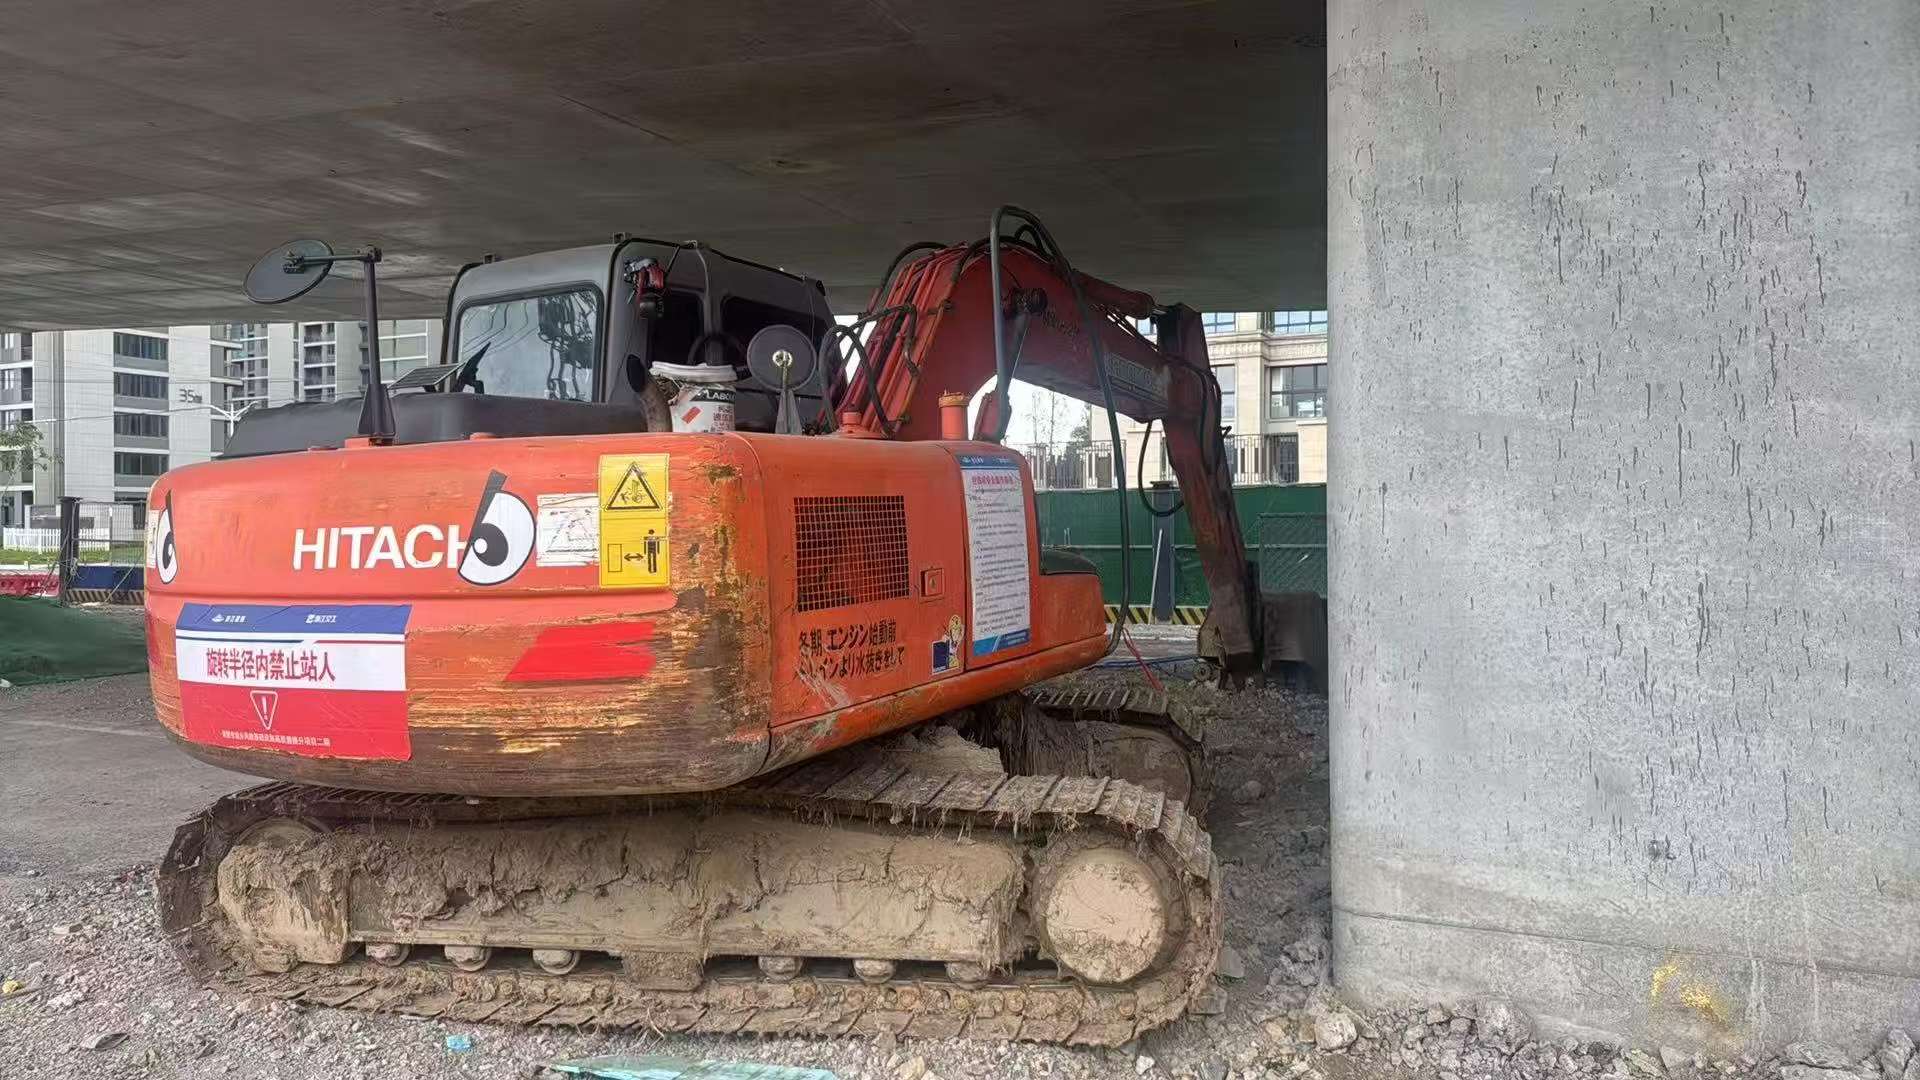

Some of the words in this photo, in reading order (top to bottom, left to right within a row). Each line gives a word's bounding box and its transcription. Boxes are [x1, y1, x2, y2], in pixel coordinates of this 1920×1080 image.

[293, 524, 467, 570] HITACH
[206, 647, 336, 682] 旋转半径内禁止站人
